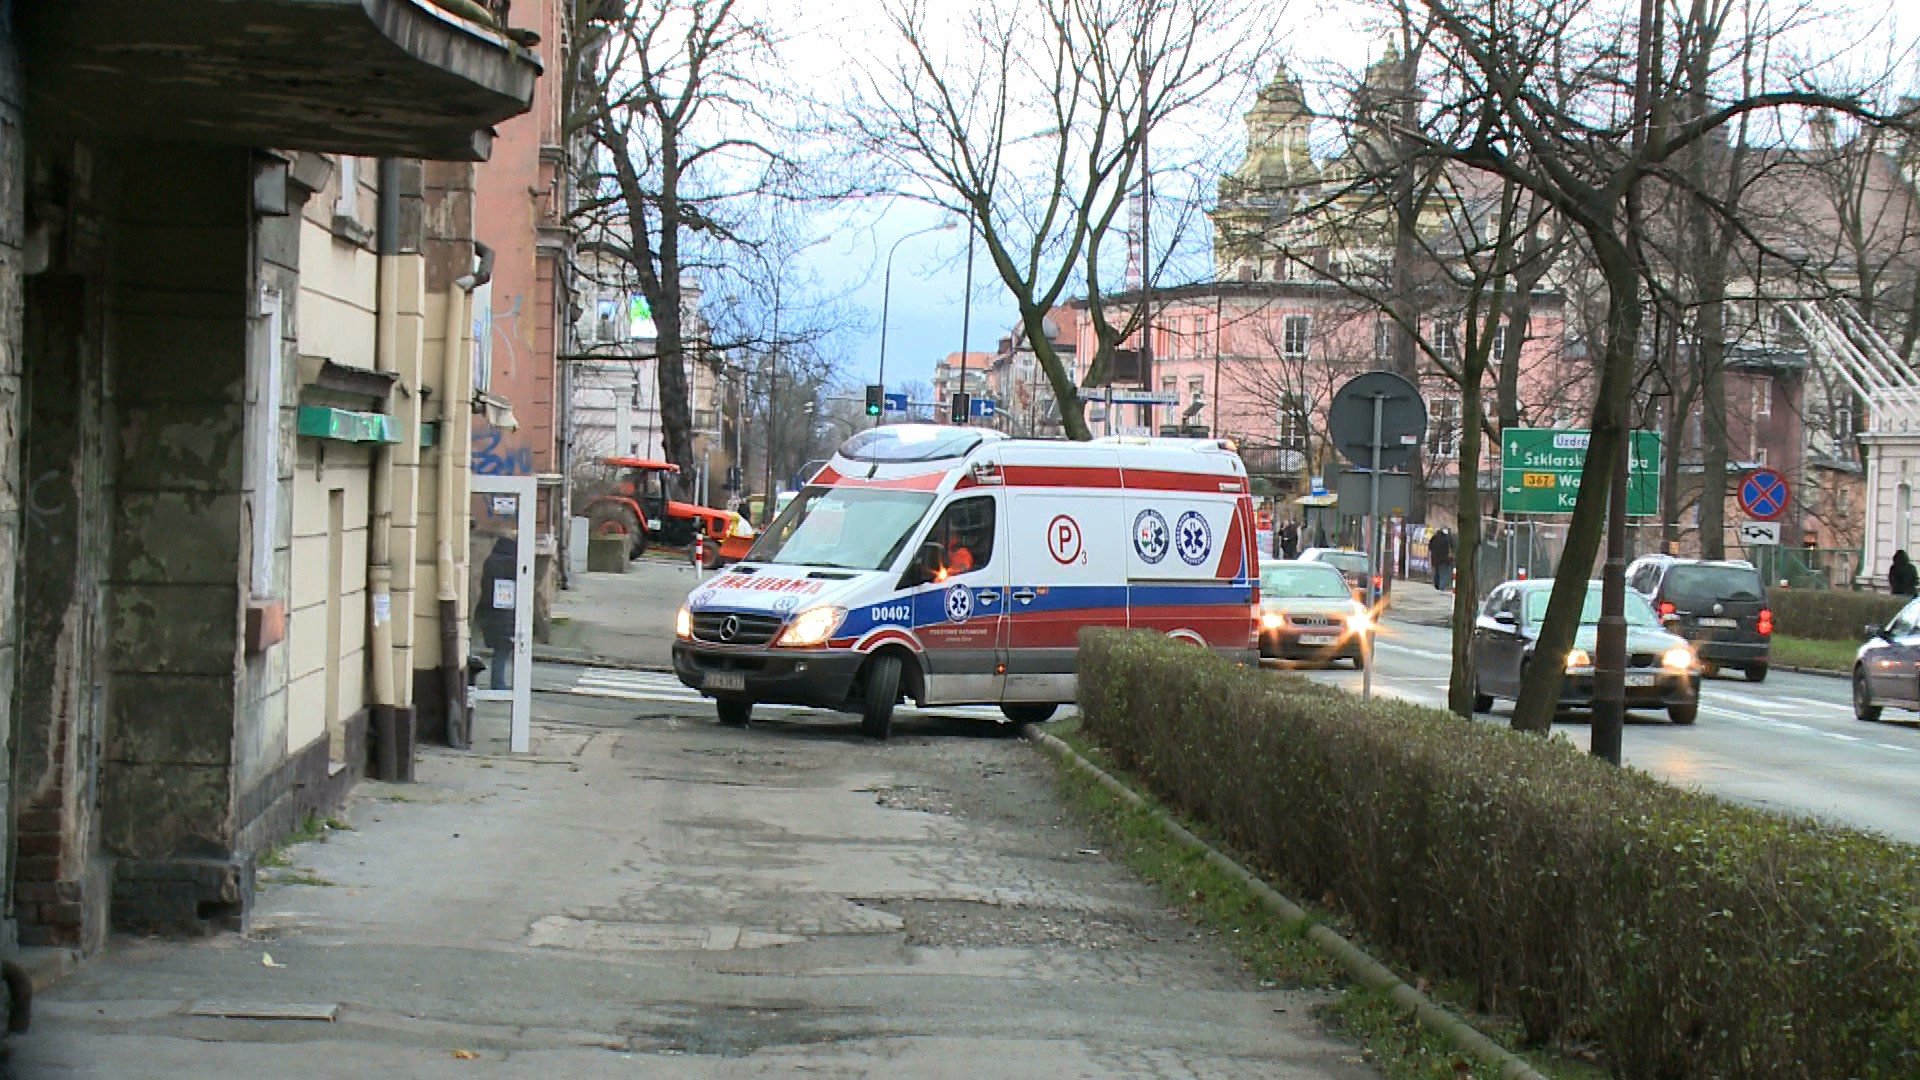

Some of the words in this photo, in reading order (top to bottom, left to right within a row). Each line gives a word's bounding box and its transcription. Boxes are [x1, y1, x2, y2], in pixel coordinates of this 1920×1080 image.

[1059, 525, 1072, 553] P
[1081, 550, 1087, 565] 3
[871, 605, 910, 621] D0402
